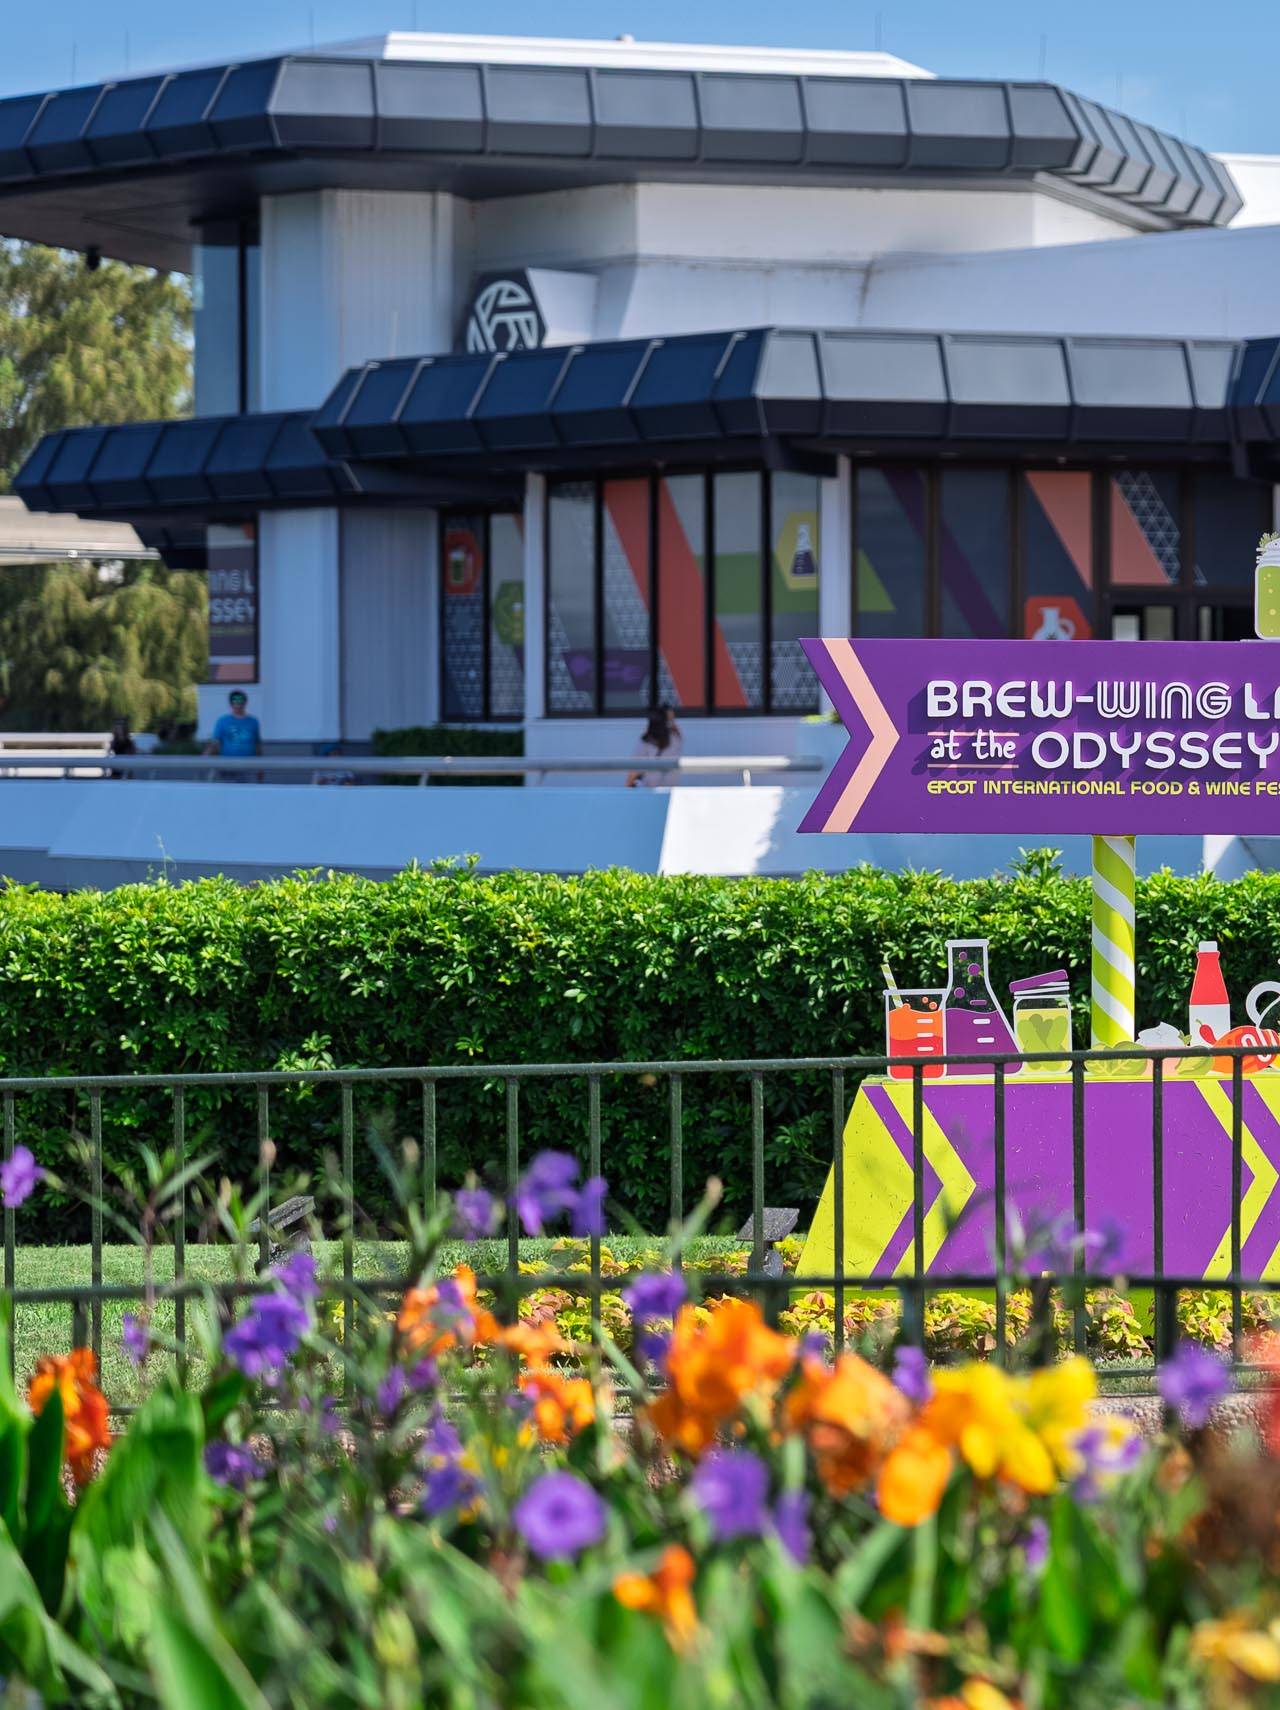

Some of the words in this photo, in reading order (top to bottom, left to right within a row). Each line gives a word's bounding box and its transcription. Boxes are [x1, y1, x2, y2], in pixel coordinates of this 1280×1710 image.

[927, 680, 1233, 720] BREW-WING
[930, 729, 962, 760] at
[971, 728, 1017, 760] the
[1031, 730, 1280, 769] ODYSSEY
[927, 779, 978, 794] EPCOT
[983, 779, 1126, 795] INTERNATIONAL
[1130, 780, 1184, 795] FOOD
[1187, 780, 1201, 795] &
[1205, 780, 1252, 796] WINE
